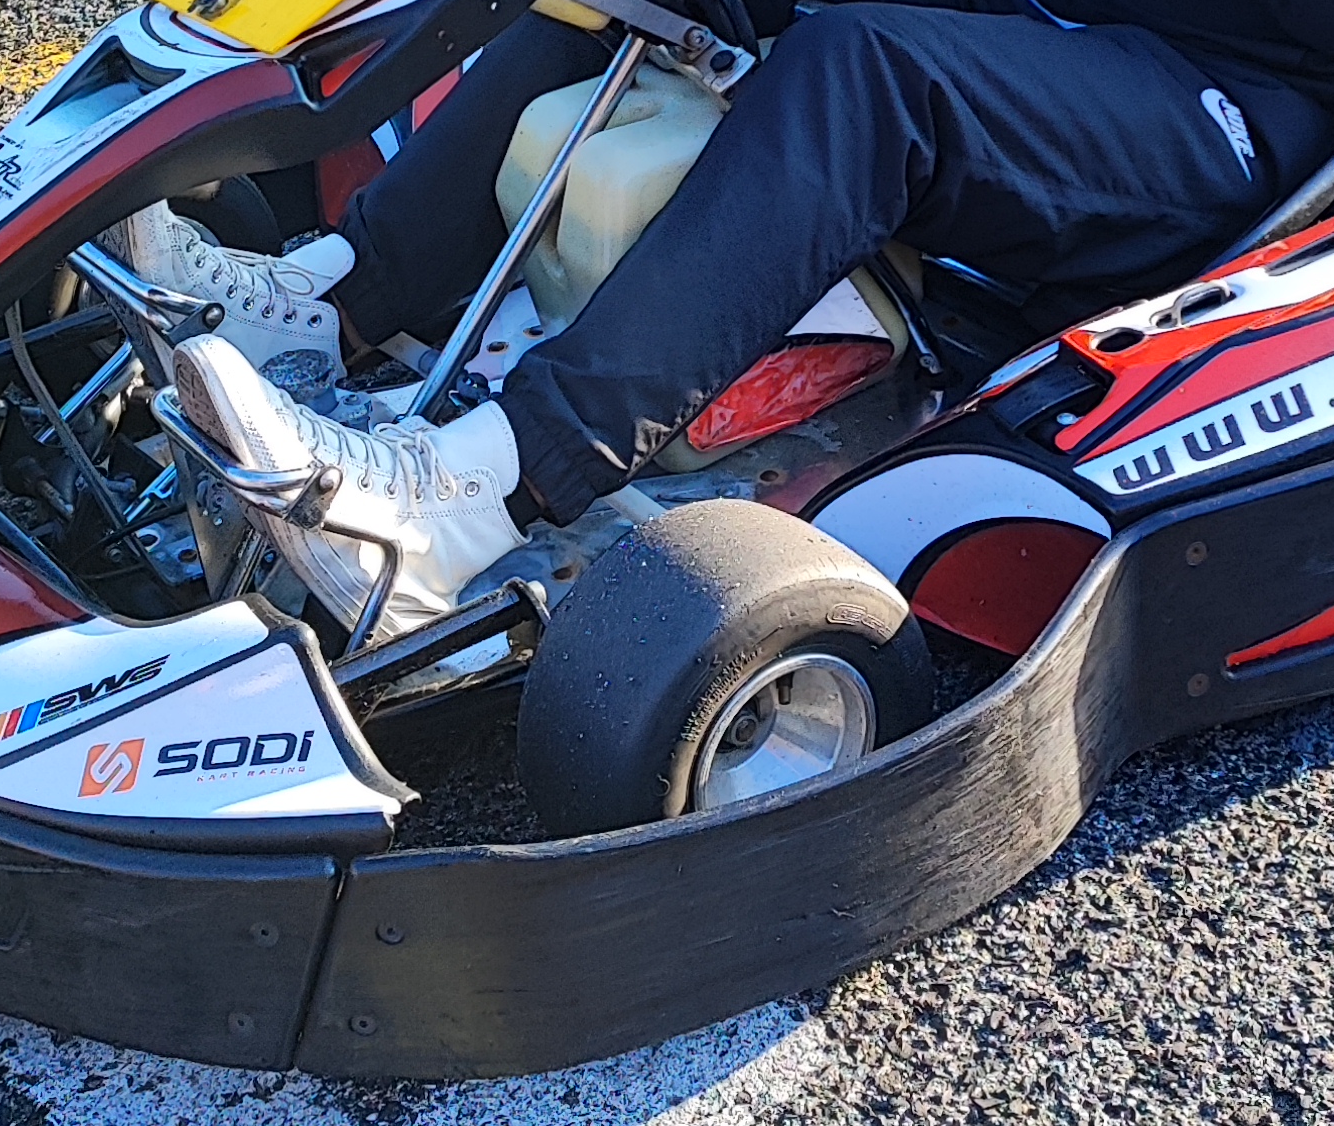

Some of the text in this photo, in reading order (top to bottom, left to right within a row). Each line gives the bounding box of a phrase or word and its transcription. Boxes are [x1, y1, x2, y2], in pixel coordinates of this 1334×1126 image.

[38, 653, 171, 720] SWS
[196, 765, 307, 783] KART RACING
